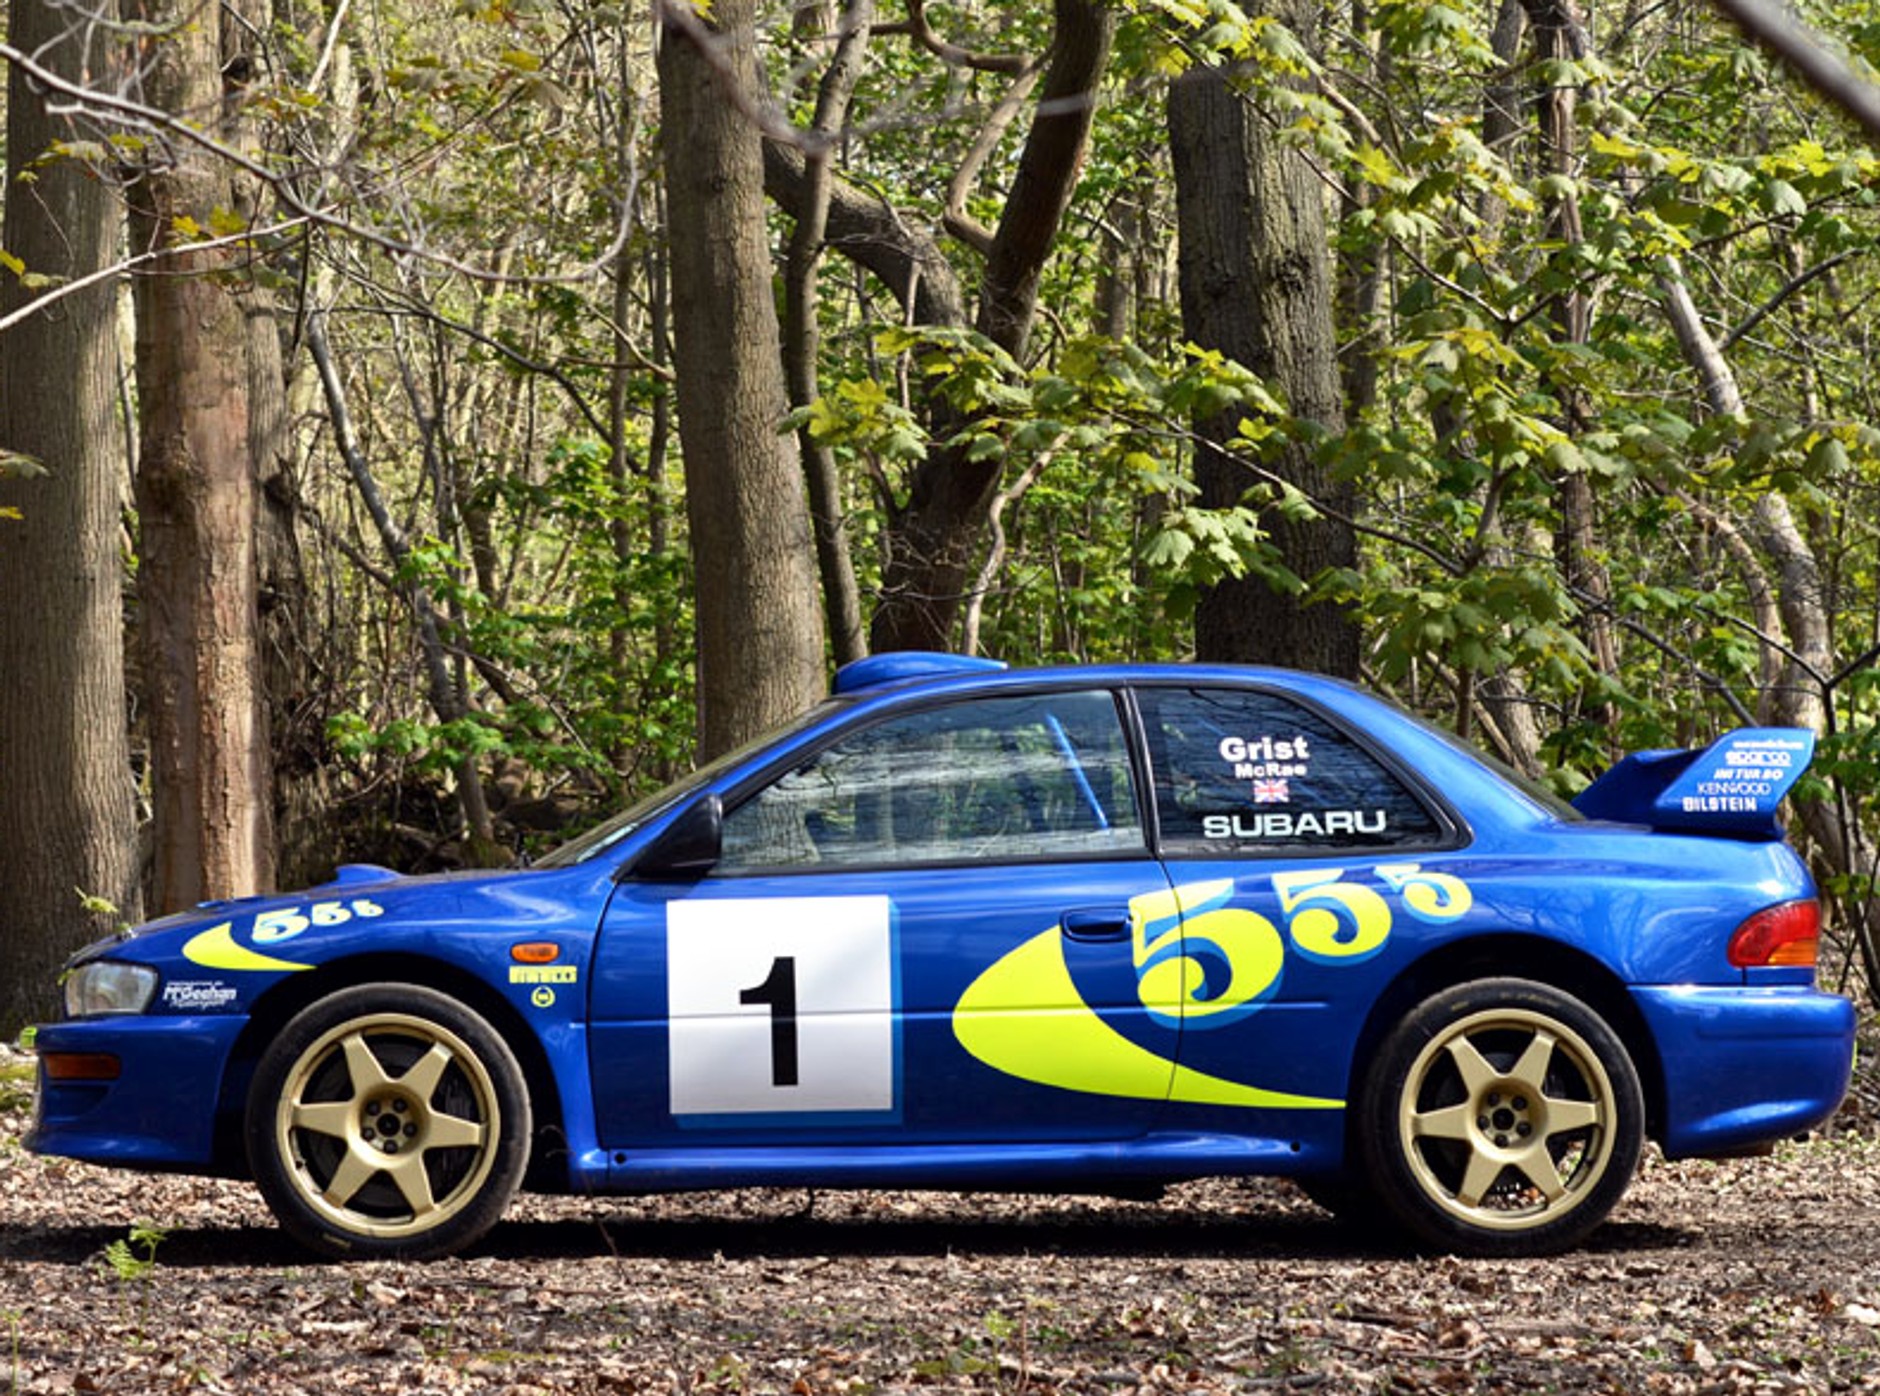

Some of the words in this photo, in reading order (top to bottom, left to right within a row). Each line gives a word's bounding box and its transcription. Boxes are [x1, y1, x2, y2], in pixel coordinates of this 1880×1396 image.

[1219, 735, 1310, 762] Grist
[1235, 762, 1307, 778] McRae
[1697, 782, 1771, 795] KENWOOD
[1682, 796, 1758, 812] BILSTEIN
[1203, 810, 1387, 839] SUBARU
[1128, 863, 1473, 1029] 555
[739, 956, 799, 1087] 1
